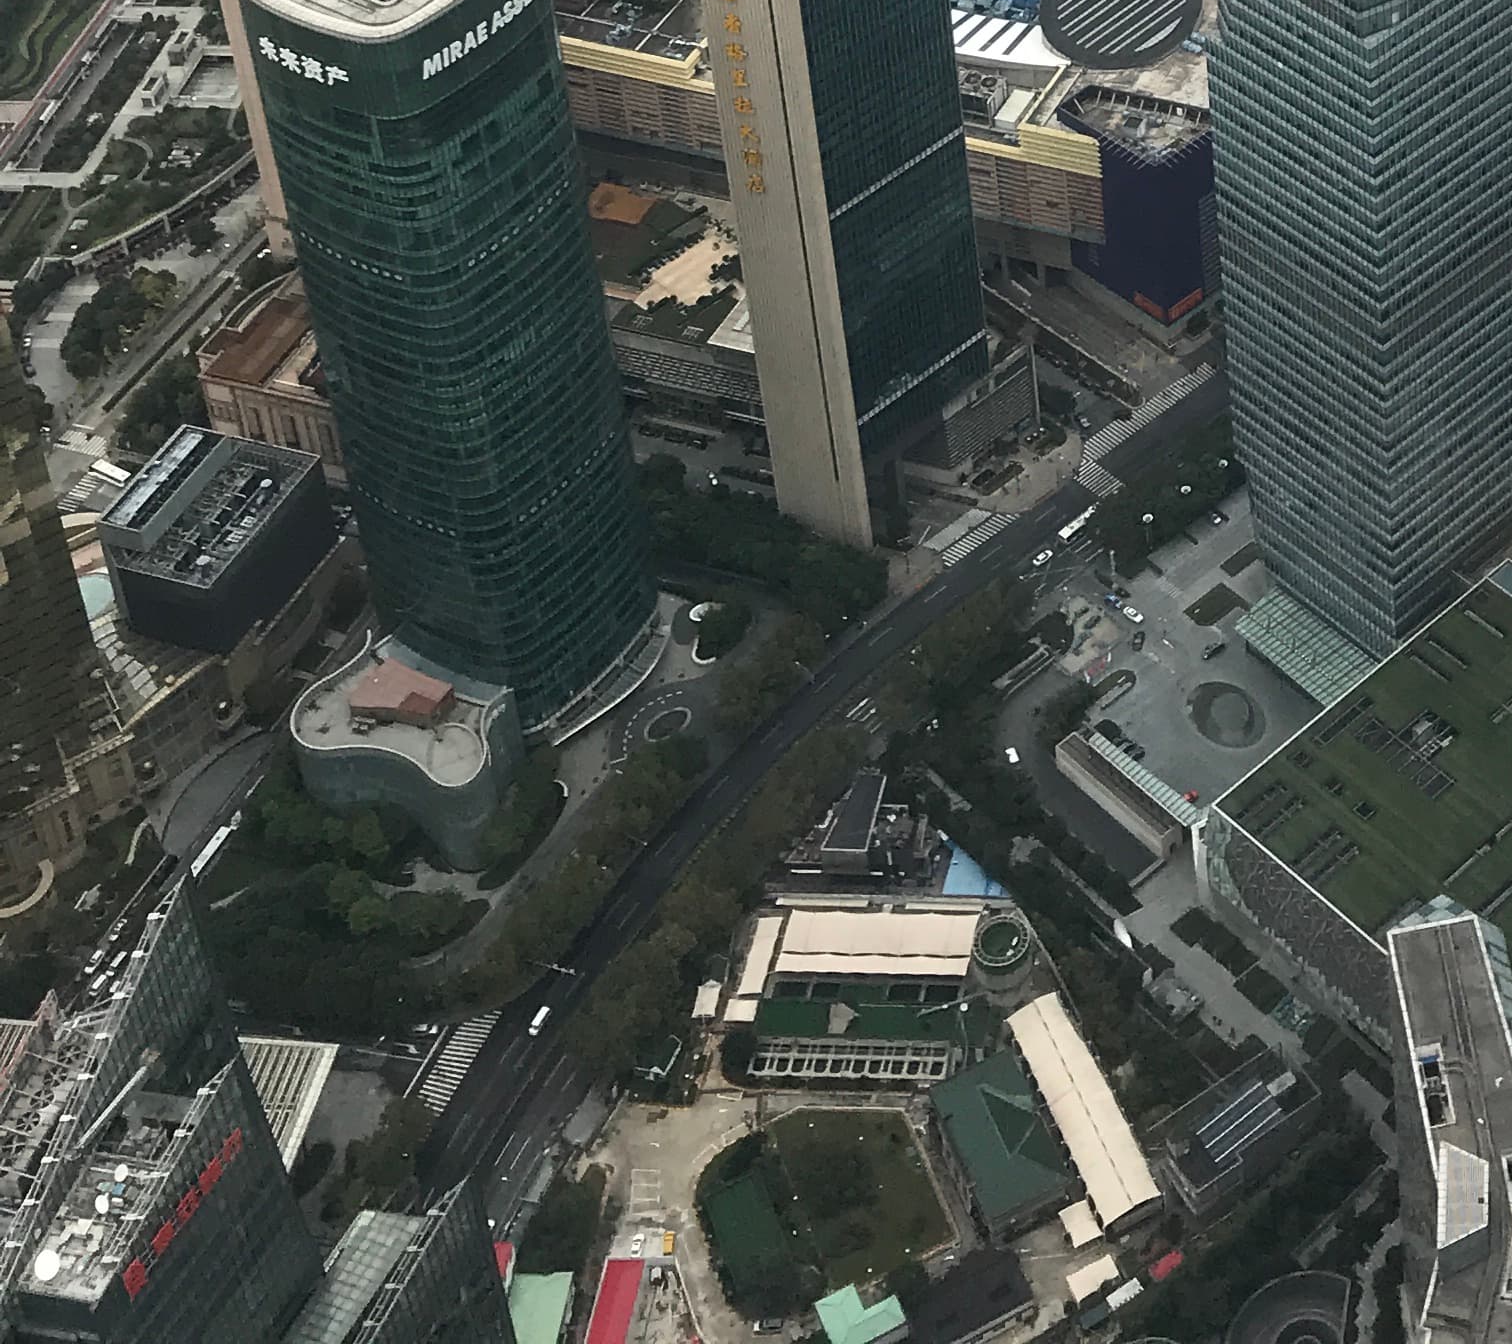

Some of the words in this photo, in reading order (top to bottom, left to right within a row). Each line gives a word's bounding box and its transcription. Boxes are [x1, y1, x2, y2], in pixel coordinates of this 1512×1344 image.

[259, 36, 349, 86] 未来资产
[422, 21, 489, 80] MIRAE
